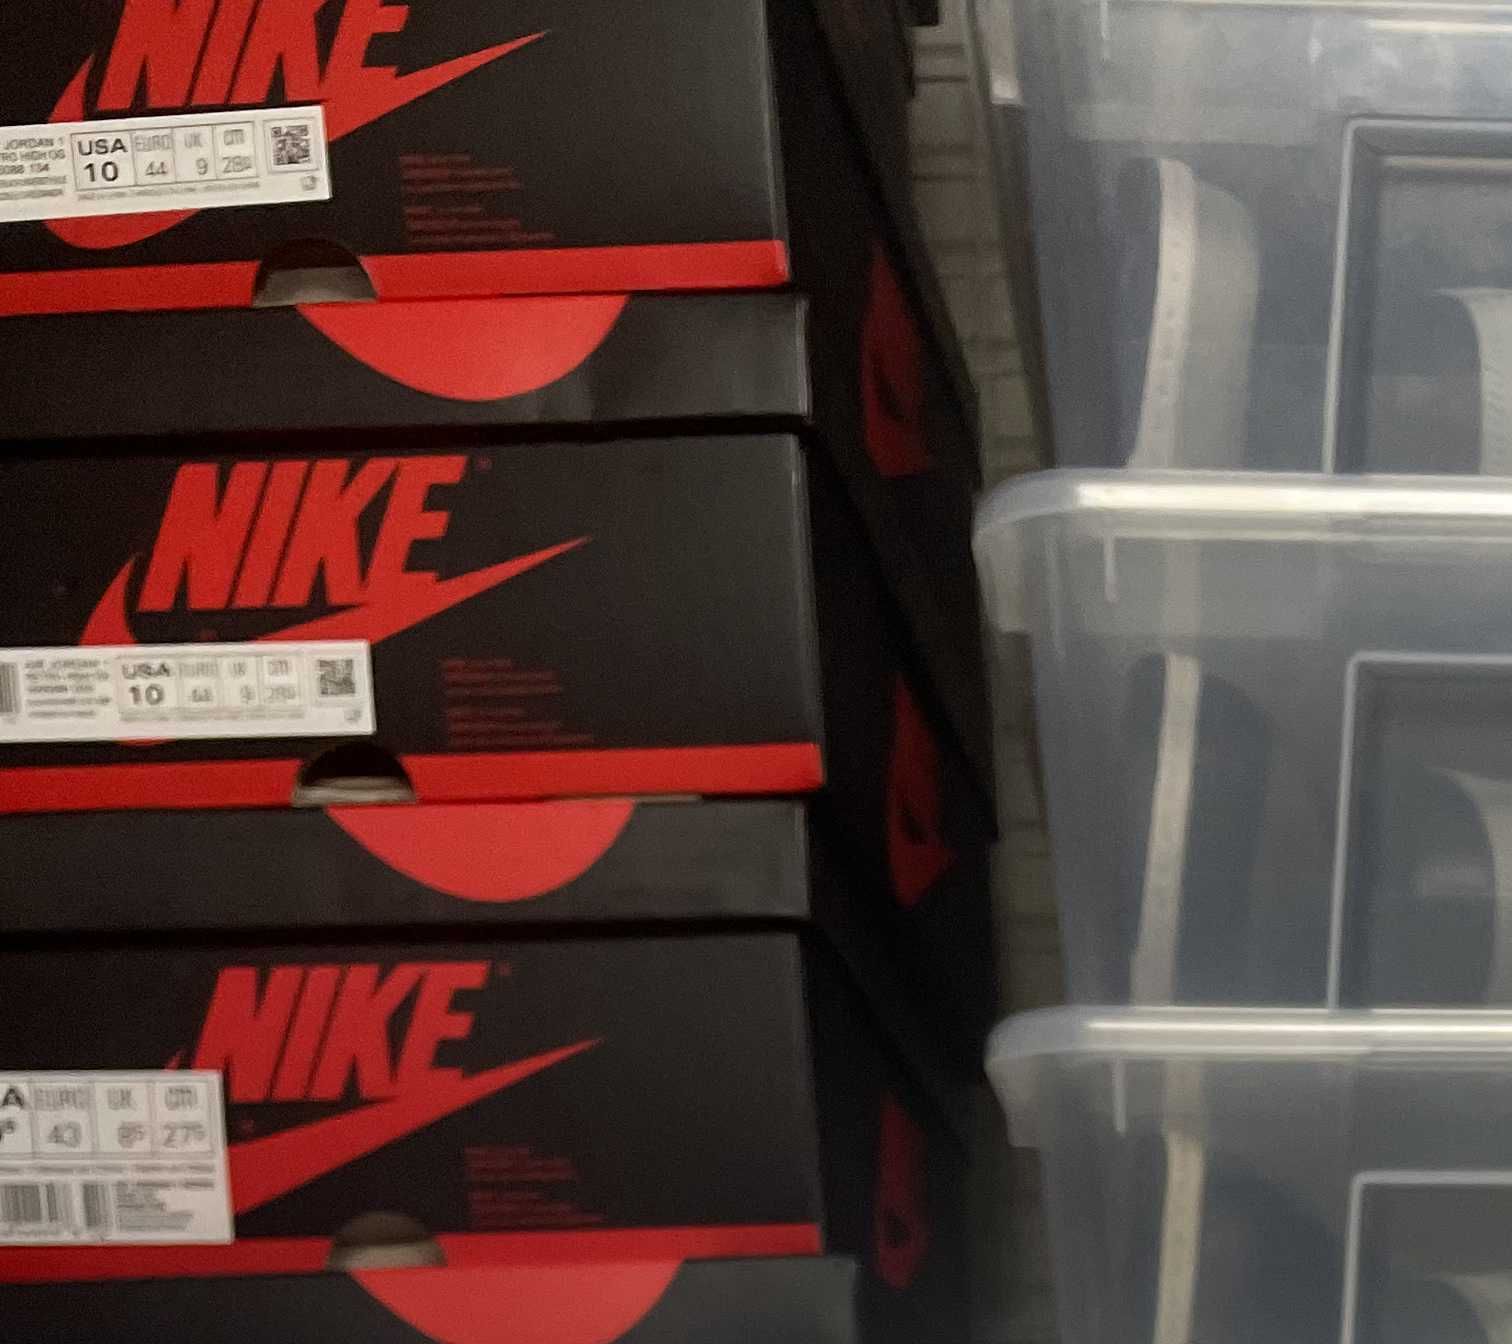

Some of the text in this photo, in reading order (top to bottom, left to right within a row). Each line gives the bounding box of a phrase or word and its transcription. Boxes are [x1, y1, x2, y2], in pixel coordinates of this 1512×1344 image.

[96, 0, 409, 110] NIKE
[77, 137, 129, 156] USA
[83, 160, 119, 182] 10
[195, 157, 209, 176] 9
[137, 454, 469, 612] NIKE
[121, 662, 170, 680] USA
[129, 683, 165, 706] 10
[190, 960, 492, 1104] NIKE
